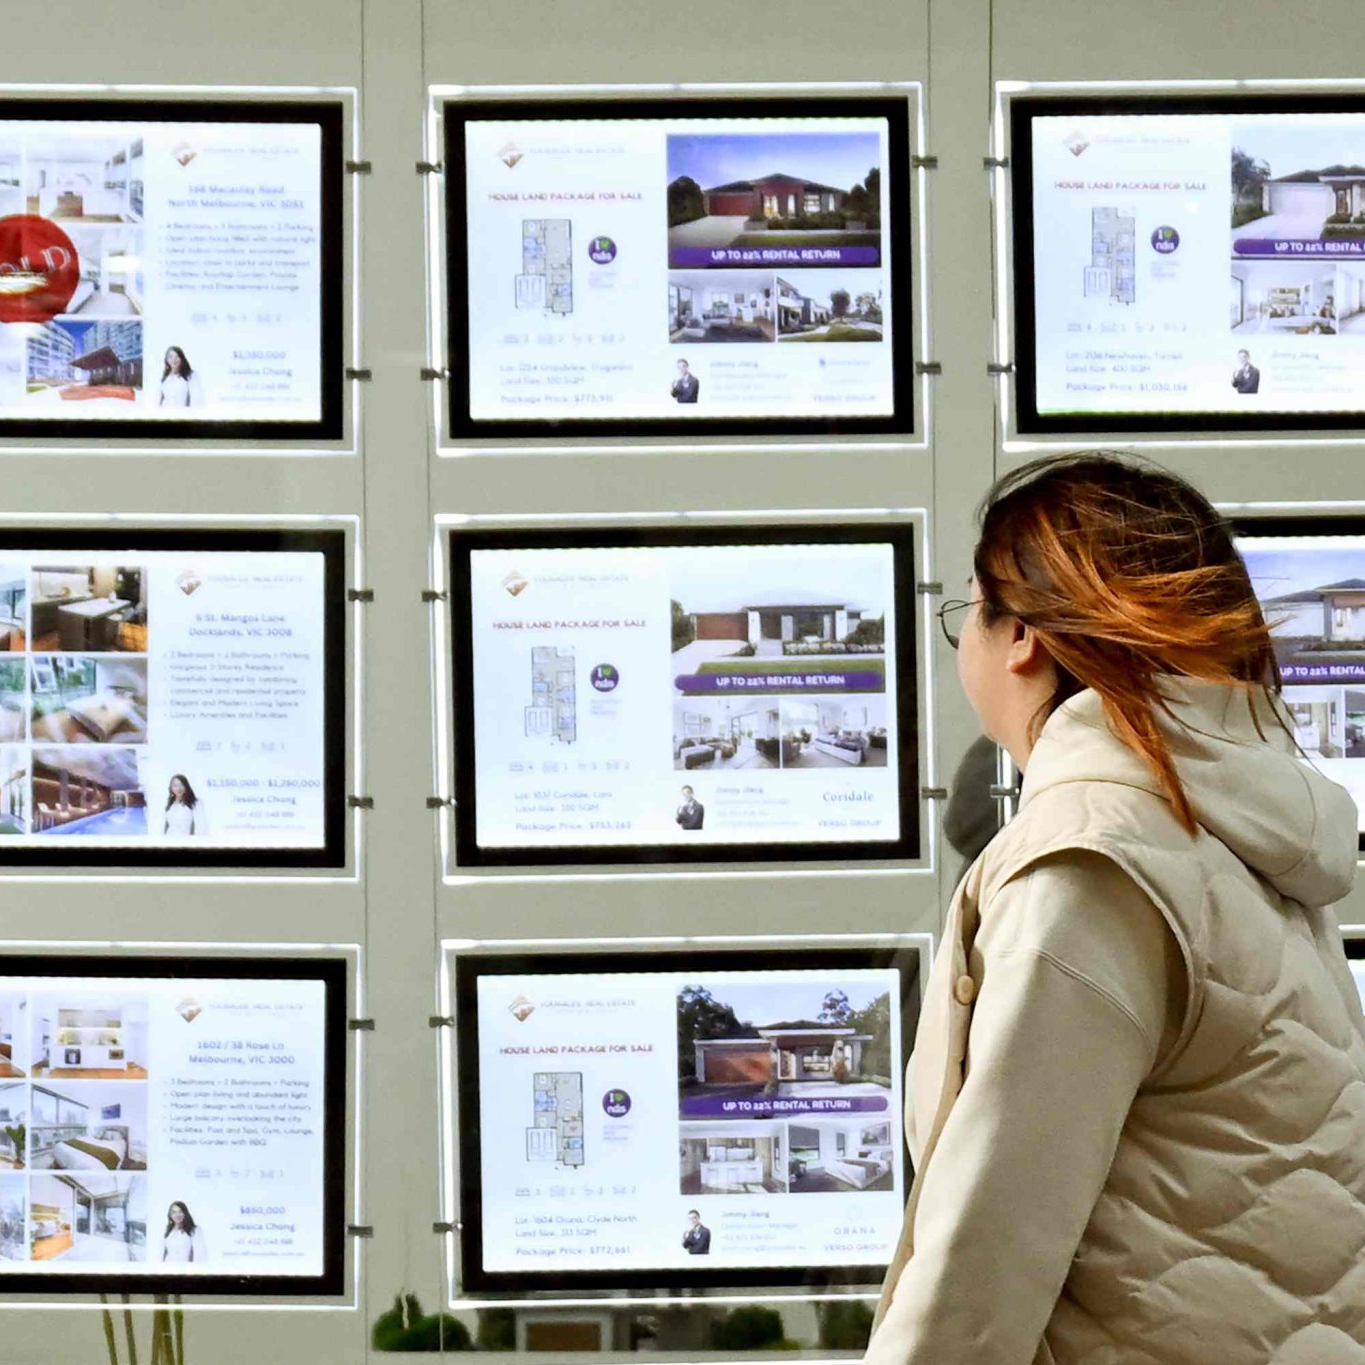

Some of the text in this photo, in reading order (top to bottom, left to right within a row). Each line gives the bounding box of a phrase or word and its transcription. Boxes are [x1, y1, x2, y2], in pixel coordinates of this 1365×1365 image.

[1054, 182, 1206, 191] HOUSE LAND PACKAGE FOR SALE
[489, 193, 519, 202] HOUSE
[522, 193, 547, 201] LAND
[599, 192, 615, 200] FOR
[1155, 241, 1175, 250] ndis
[1275, 242, 1289, 252] UP
[1290, 240, 1304, 252] TO
[1325, 243, 1361, 253] RENTAL
[593, 251, 612, 260] ndis
[712, 251, 726, 261] UP
[728, 250, 741, 261] TO
[762, 250, 800, 261] RENTAL
[801, 250, 841, 260] RETURN
[493, 622, 523, 630] HOUSE
[526, 621, 552, 630] LAND
[603, 620, 620, 628] FOR
[625, 620, 645, 628] SALE
[189, 629, 245, 637] Docklands,
[247, 628, 262, 637] VIC
[1280, 667, 1294, 677] UP
[1295, 667, 1309, 677] TO
[1330, 666, 1365, 677] RENTAL
[595, 678, 614, 688] ndis
[716, 677, 730, 687] UP
[732, 677, 746, 687] TO
[767, 676, 803, 686] RENTAL
[805, 676, 845, 685] RETURN
[267, 796, 297, 805] Chong
[823, 792, 873, 802] Coridale
[851, 819, 881, 827] GROUP
[500, 1047, 530, 1055] HOUSE
[533, 1046, 558, 1054] LAND
[562, 1046, 606, 1054] PACKAGE
[609, 1045, 627, 1053] FOR
[189, 1056, 295, 1065] Melbourne, VIC 3000
[607, 1104, 626, 1114] ndis
[723, 1102, 737, 1111] UP
[739, 1102, 752, 1111] TO
[773, 1101, 811, 1110] RENTAL
[812, 1099, 851, 1109] RETURN
[266, 1223, 295, 1232] Chong
[516, 1248, 556, 1256] Package
[825, 1244, 853, 1252] VERSO
